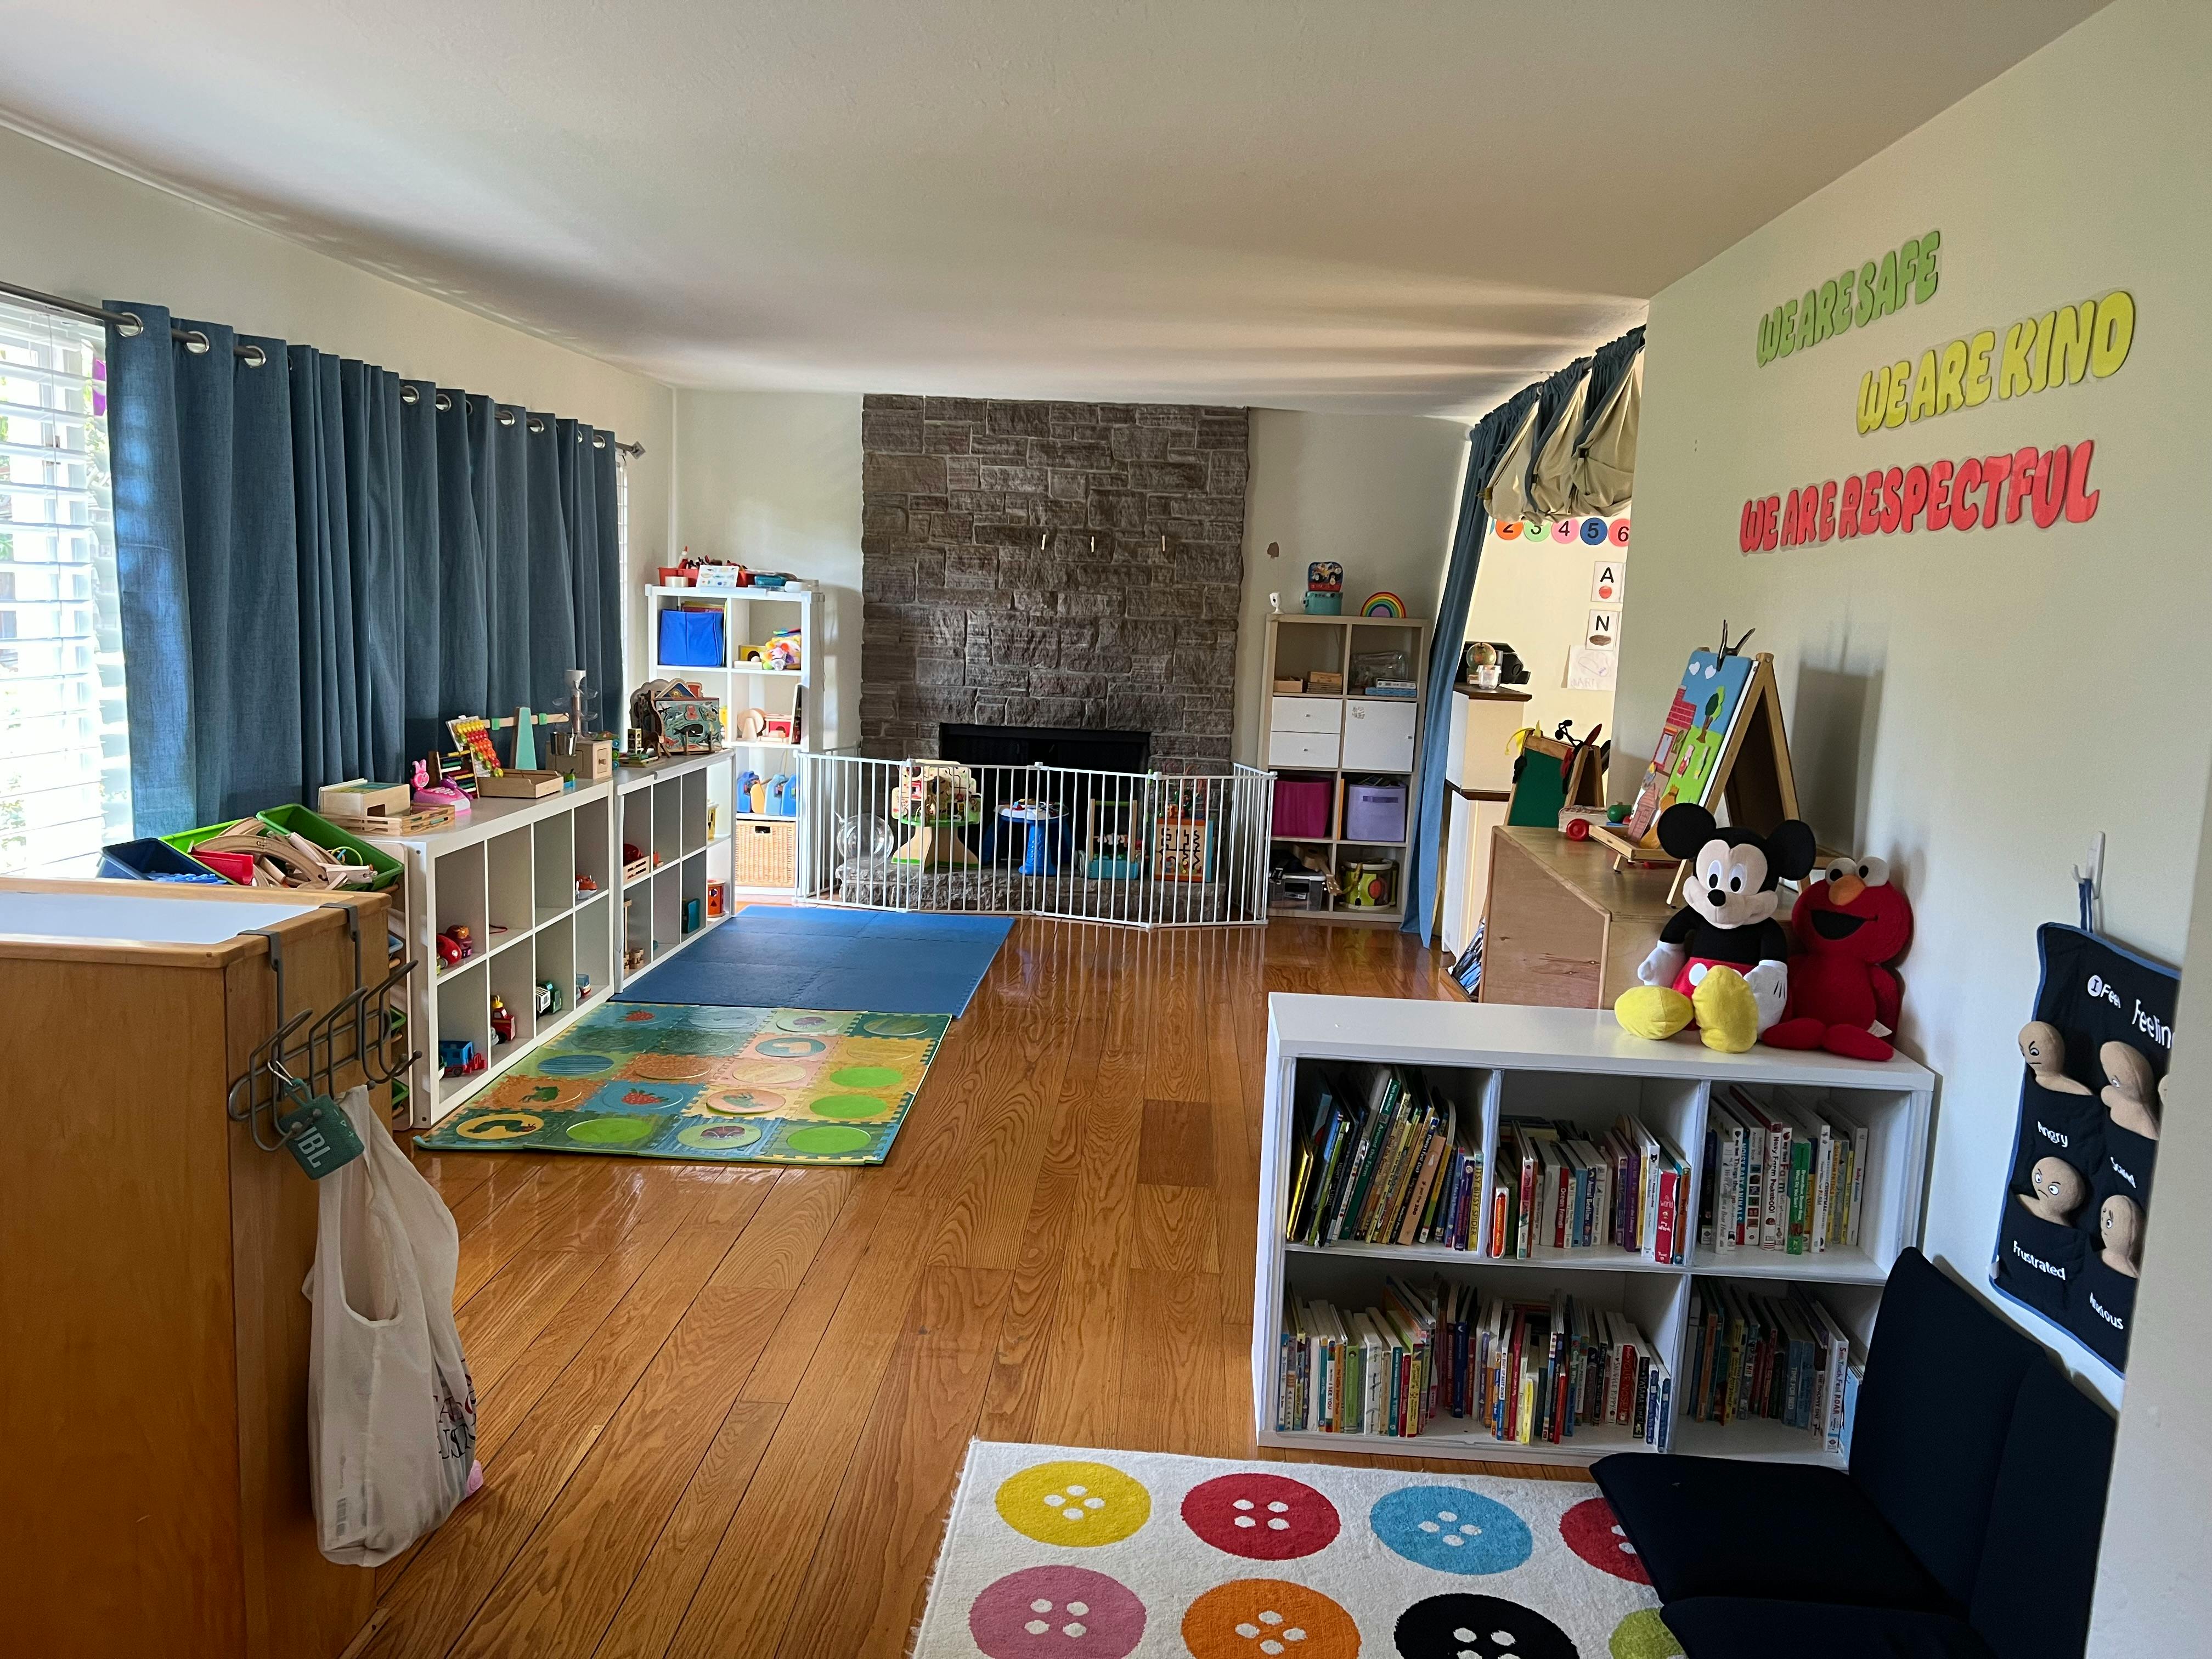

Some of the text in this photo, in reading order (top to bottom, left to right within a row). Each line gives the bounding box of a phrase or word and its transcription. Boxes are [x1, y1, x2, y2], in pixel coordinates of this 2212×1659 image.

[1758, 231, 1940, 367] WE ARE SAFE
[1857, 291, 2136, 434] WE ARE KIND
[1740, 439, 2100, 553] WE ARE RESPECTFUL
[1558, 521, 1570, 536] 4
[1588, 523, 1599, 539] 5
[1618, 527, 1629, 541] 6
[1600, 567, 1614, 583] A
[1595, 615, 1610, 631] N
[2100, 984, 2121, 1008] Feel
[2132, 998, 2174, 1049] Feelin
[1371, 1124, 1385, 1148] Around
[2038, 1121, 2068, 1148] Angry
[294, 1126, 330, 1168] JBL
[1362, 1160, 1372, 1177] Farm
[1474, 1168, 1482, 1184] ITSY
[1471, 1187, 1481, 1207] BITSY
[2013, 1240, 2066, 1280] Frustrated
[1637, 1375, 1646, 1403] PAJAMA
[1833, 1395, 1841, 1414] ROAR
